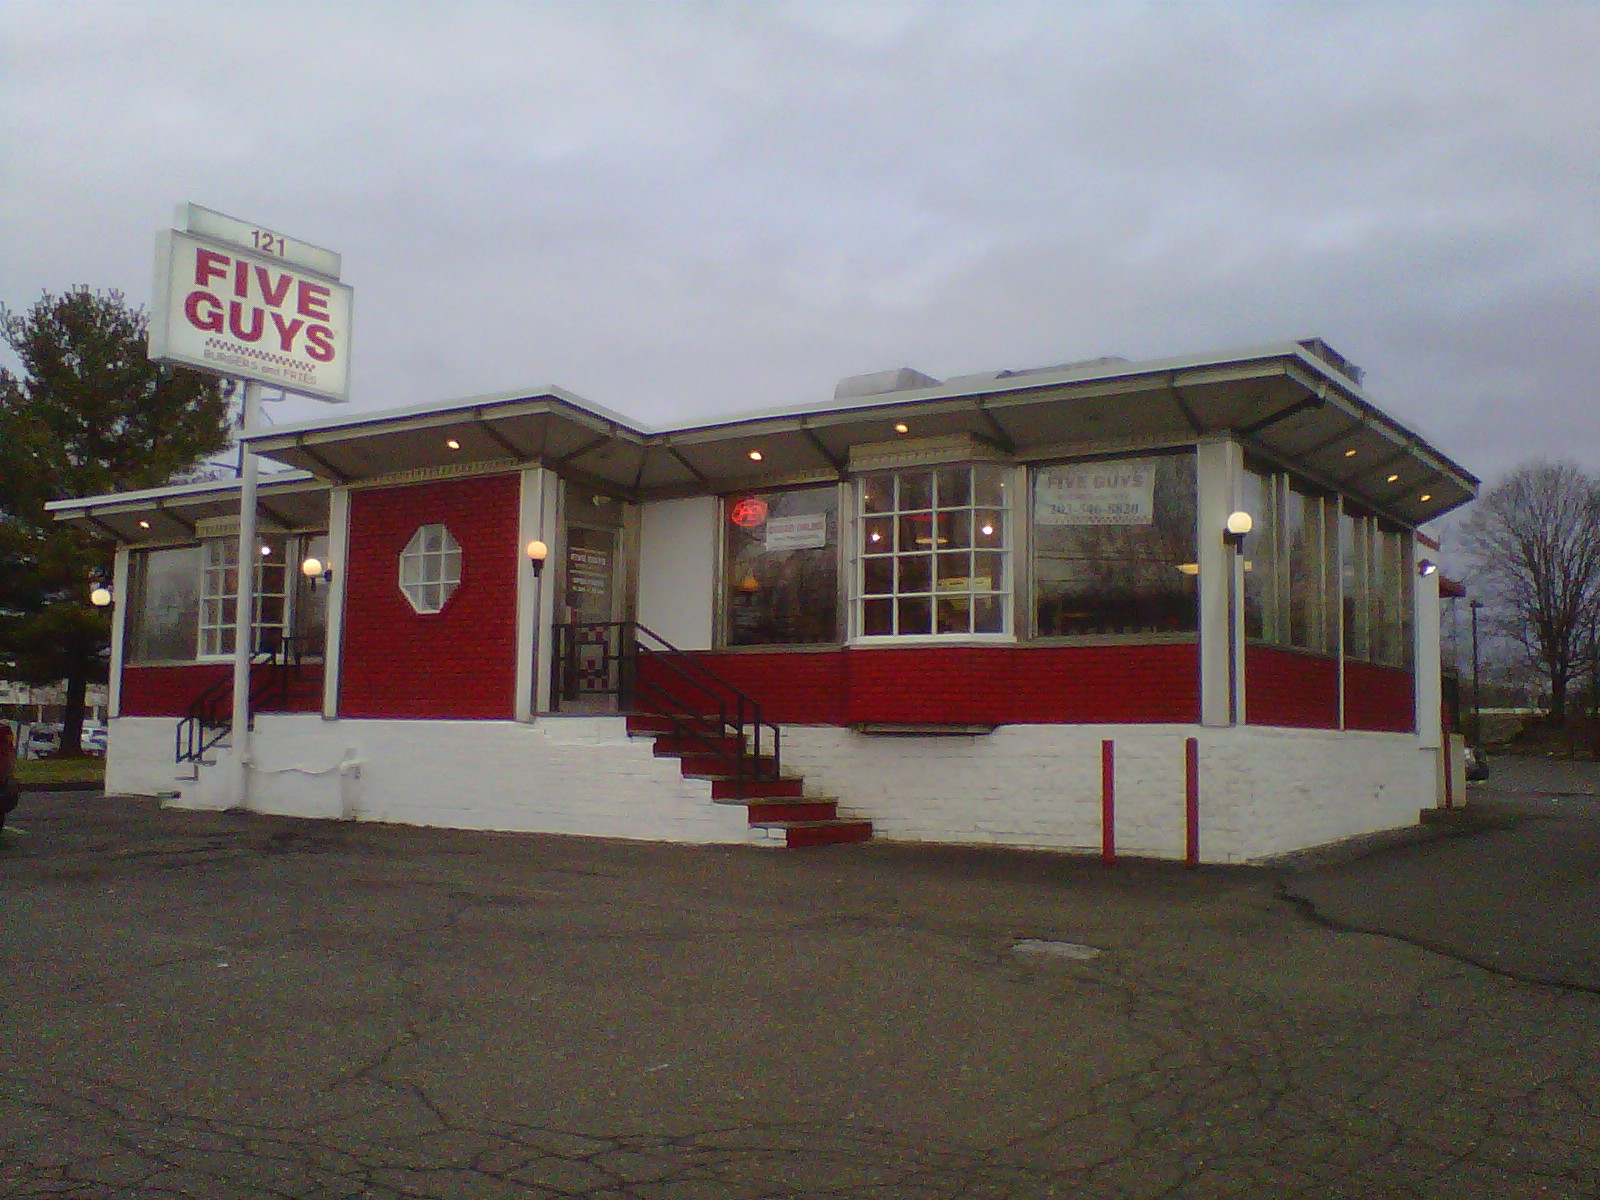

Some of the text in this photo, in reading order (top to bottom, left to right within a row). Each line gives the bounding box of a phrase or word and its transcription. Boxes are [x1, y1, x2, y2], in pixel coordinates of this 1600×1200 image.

[252, 230, 285, 257] 121
[195, 247, 331, 322] FIVE
[184, 291, 336, 362] GUYS
